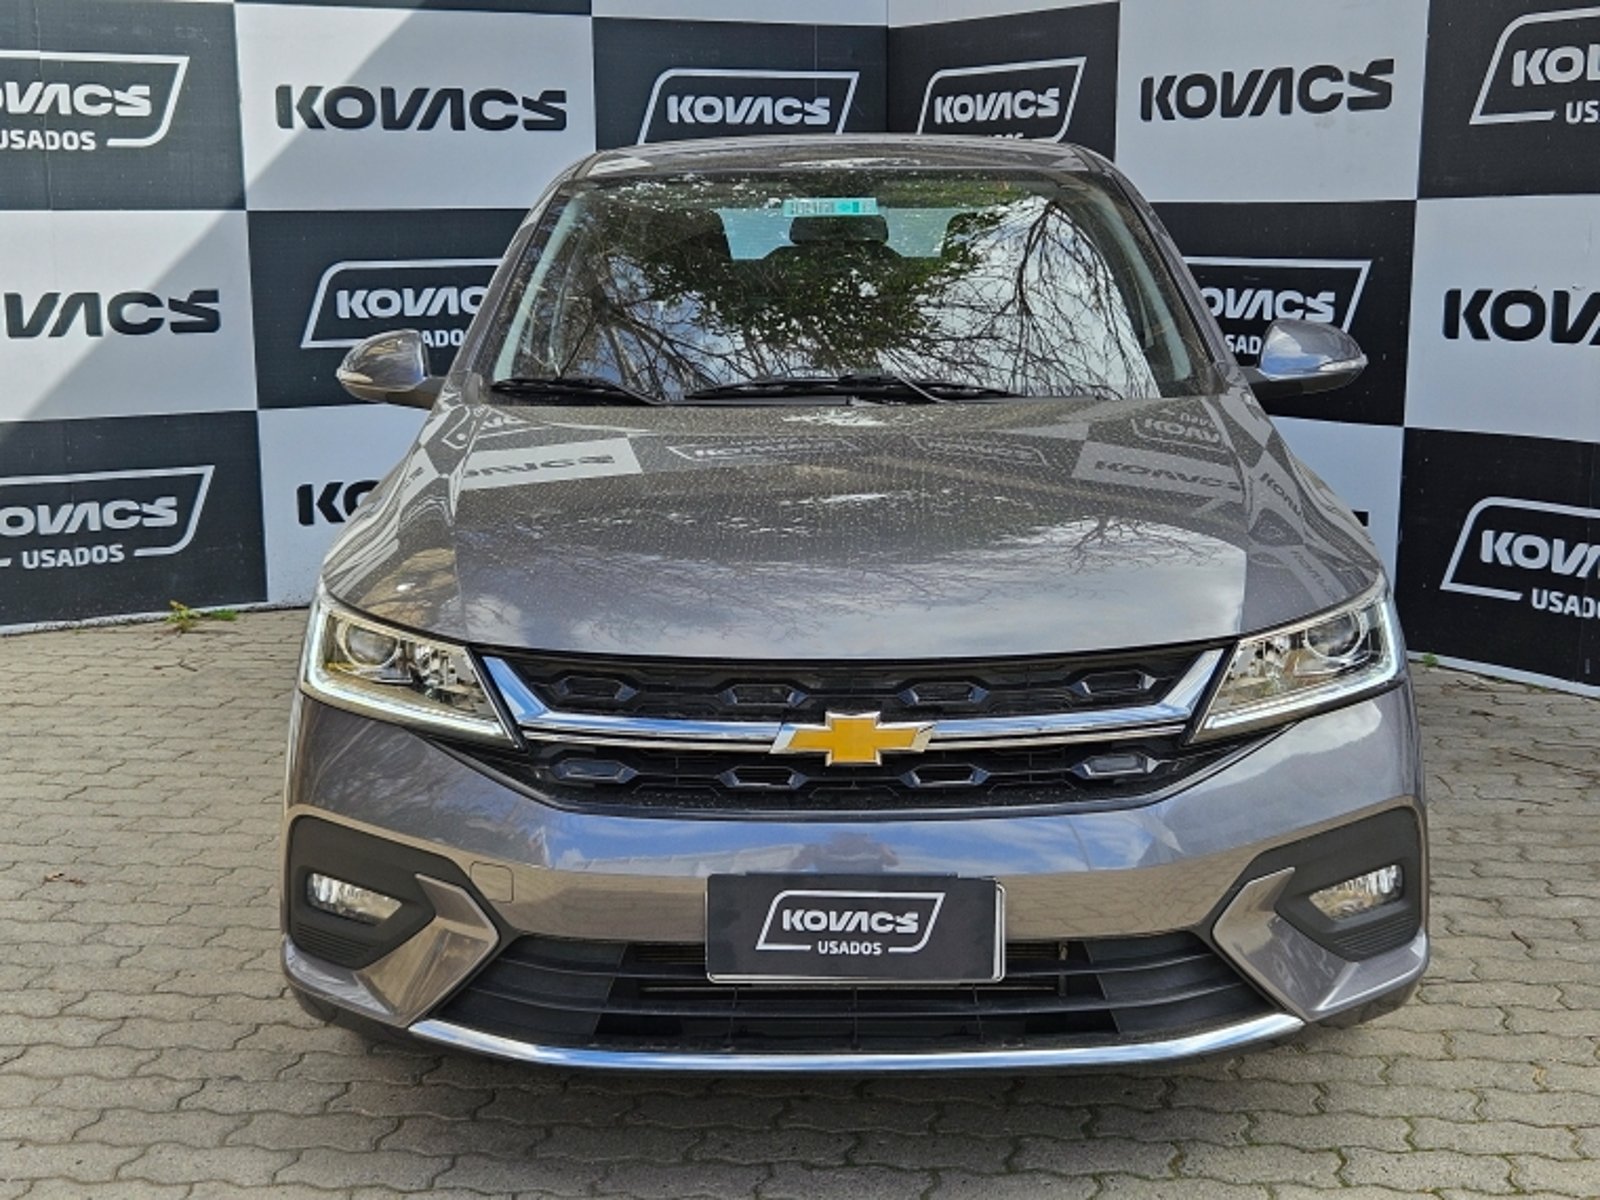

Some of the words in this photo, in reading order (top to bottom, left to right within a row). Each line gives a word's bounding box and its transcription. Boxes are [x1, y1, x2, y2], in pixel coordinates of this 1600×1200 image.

[0, 81, 152, 117] VACS
[934, 87, 1060, 125] KOVACS
[1140, 59, 1394, 122] KOVACS
[276, 85, 567, 131] KOVACS
[667, 95, 831, 126] KOVACS
[1442, 289, 1600, 346] KOV
[22, 543, 125, 570] USADOS
[1531, 587, 1600, 620] USAD
[782, 909, 919, 934] KOVACS
[818, 941, 883, 956] USADOS
